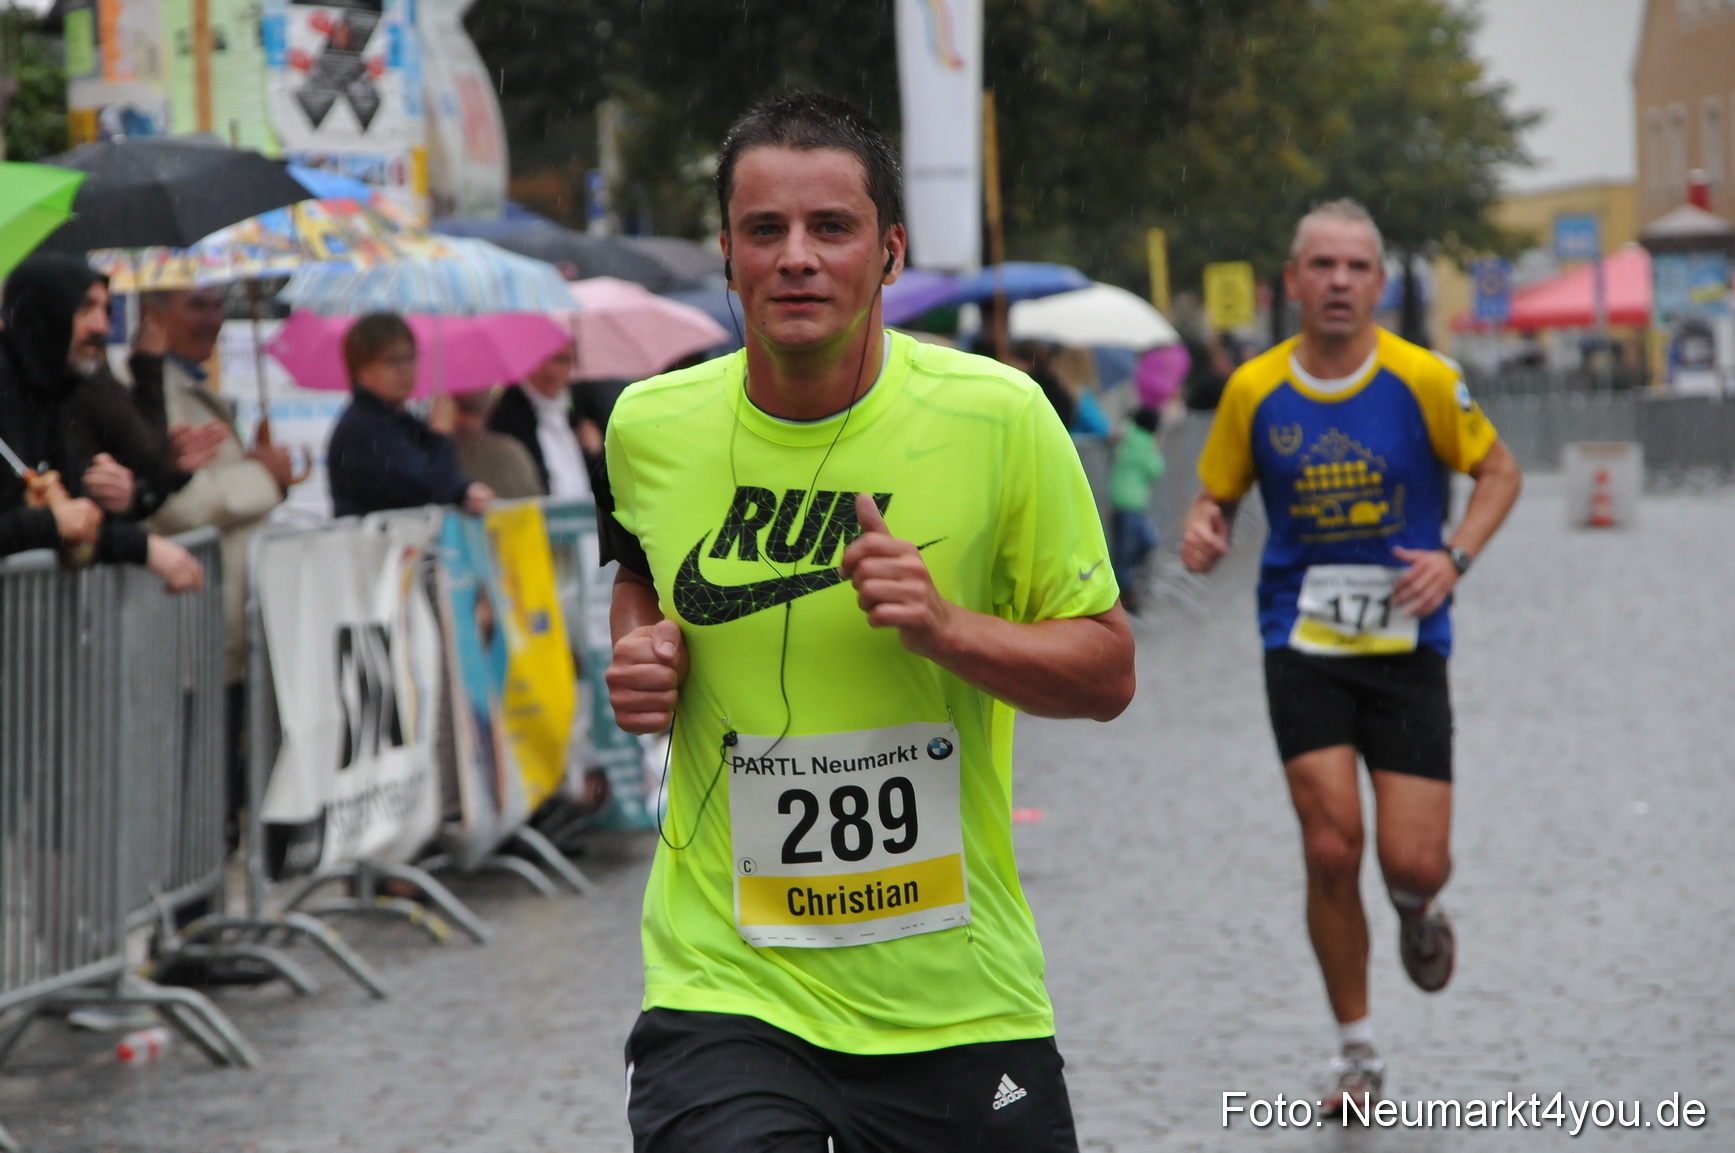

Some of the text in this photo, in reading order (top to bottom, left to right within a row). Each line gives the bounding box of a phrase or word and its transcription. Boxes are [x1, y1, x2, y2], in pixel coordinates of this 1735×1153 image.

[1327, 593, 1392, 630] 171
[732, 745, 917, 776] PARTL Neumarkt
[778, 776, 918, 864] 289
[787, 881, 918, 916] Christian
[992, 1087, 1027, 1111] adidas
